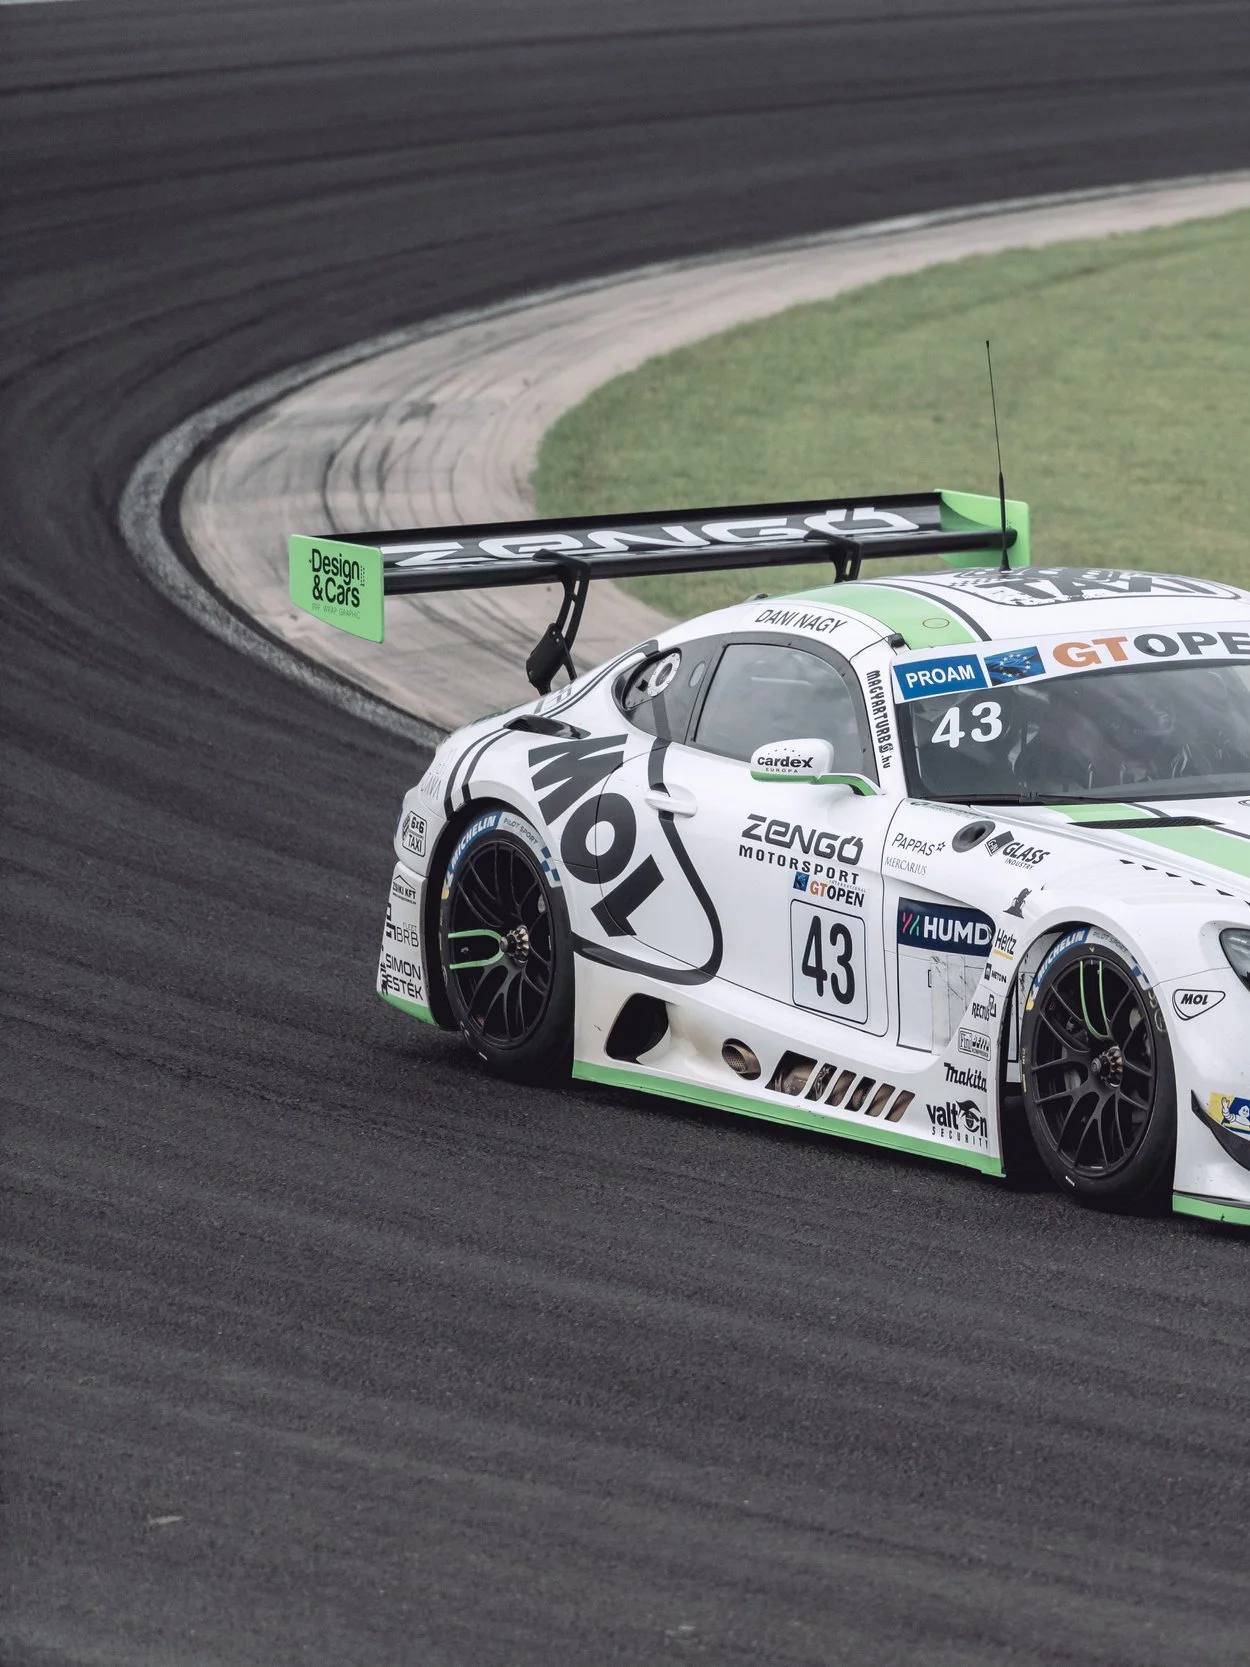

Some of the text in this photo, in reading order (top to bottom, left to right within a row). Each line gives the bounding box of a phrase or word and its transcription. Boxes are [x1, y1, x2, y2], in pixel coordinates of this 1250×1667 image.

[312, 548, 360, 586] Design
[754, 609, 848, 634] DANI NAGY
[905, 664, 976, 689] PROAM
[931, 701, 1003, 749] 43
[757, 756, 814, 769] cardex
[408, 834, 422, 853] TAXI
[451, 815, 498, 870] MICHELIN
[503, 817, 539, 845] PILOT SPORT
[528, 733, 665, 938] MOL
[891, 832, 936, 857] PAPPAS
[1002, 841, 1051, 865] GLASS
[738, 844, 859, 886] MOTORSPORT
[884, 856, 928, 876] MERCARIUS
[1004, 857, 1035, 870] INDUSTRY
[396, 926, 419, 948] BRB
[994, 928, 1017, 955] Hertz
[385, 953, 422, 981] SIMON
[801, 915, 856, 1005] 43
[1037, 929, 1086, 983] MICHELIN
[971, 1002, 990, 1022] RECTUS
[1180, 993, 1209, 1006] MOL
[931, 1125, 989, 1150] SECURITY
